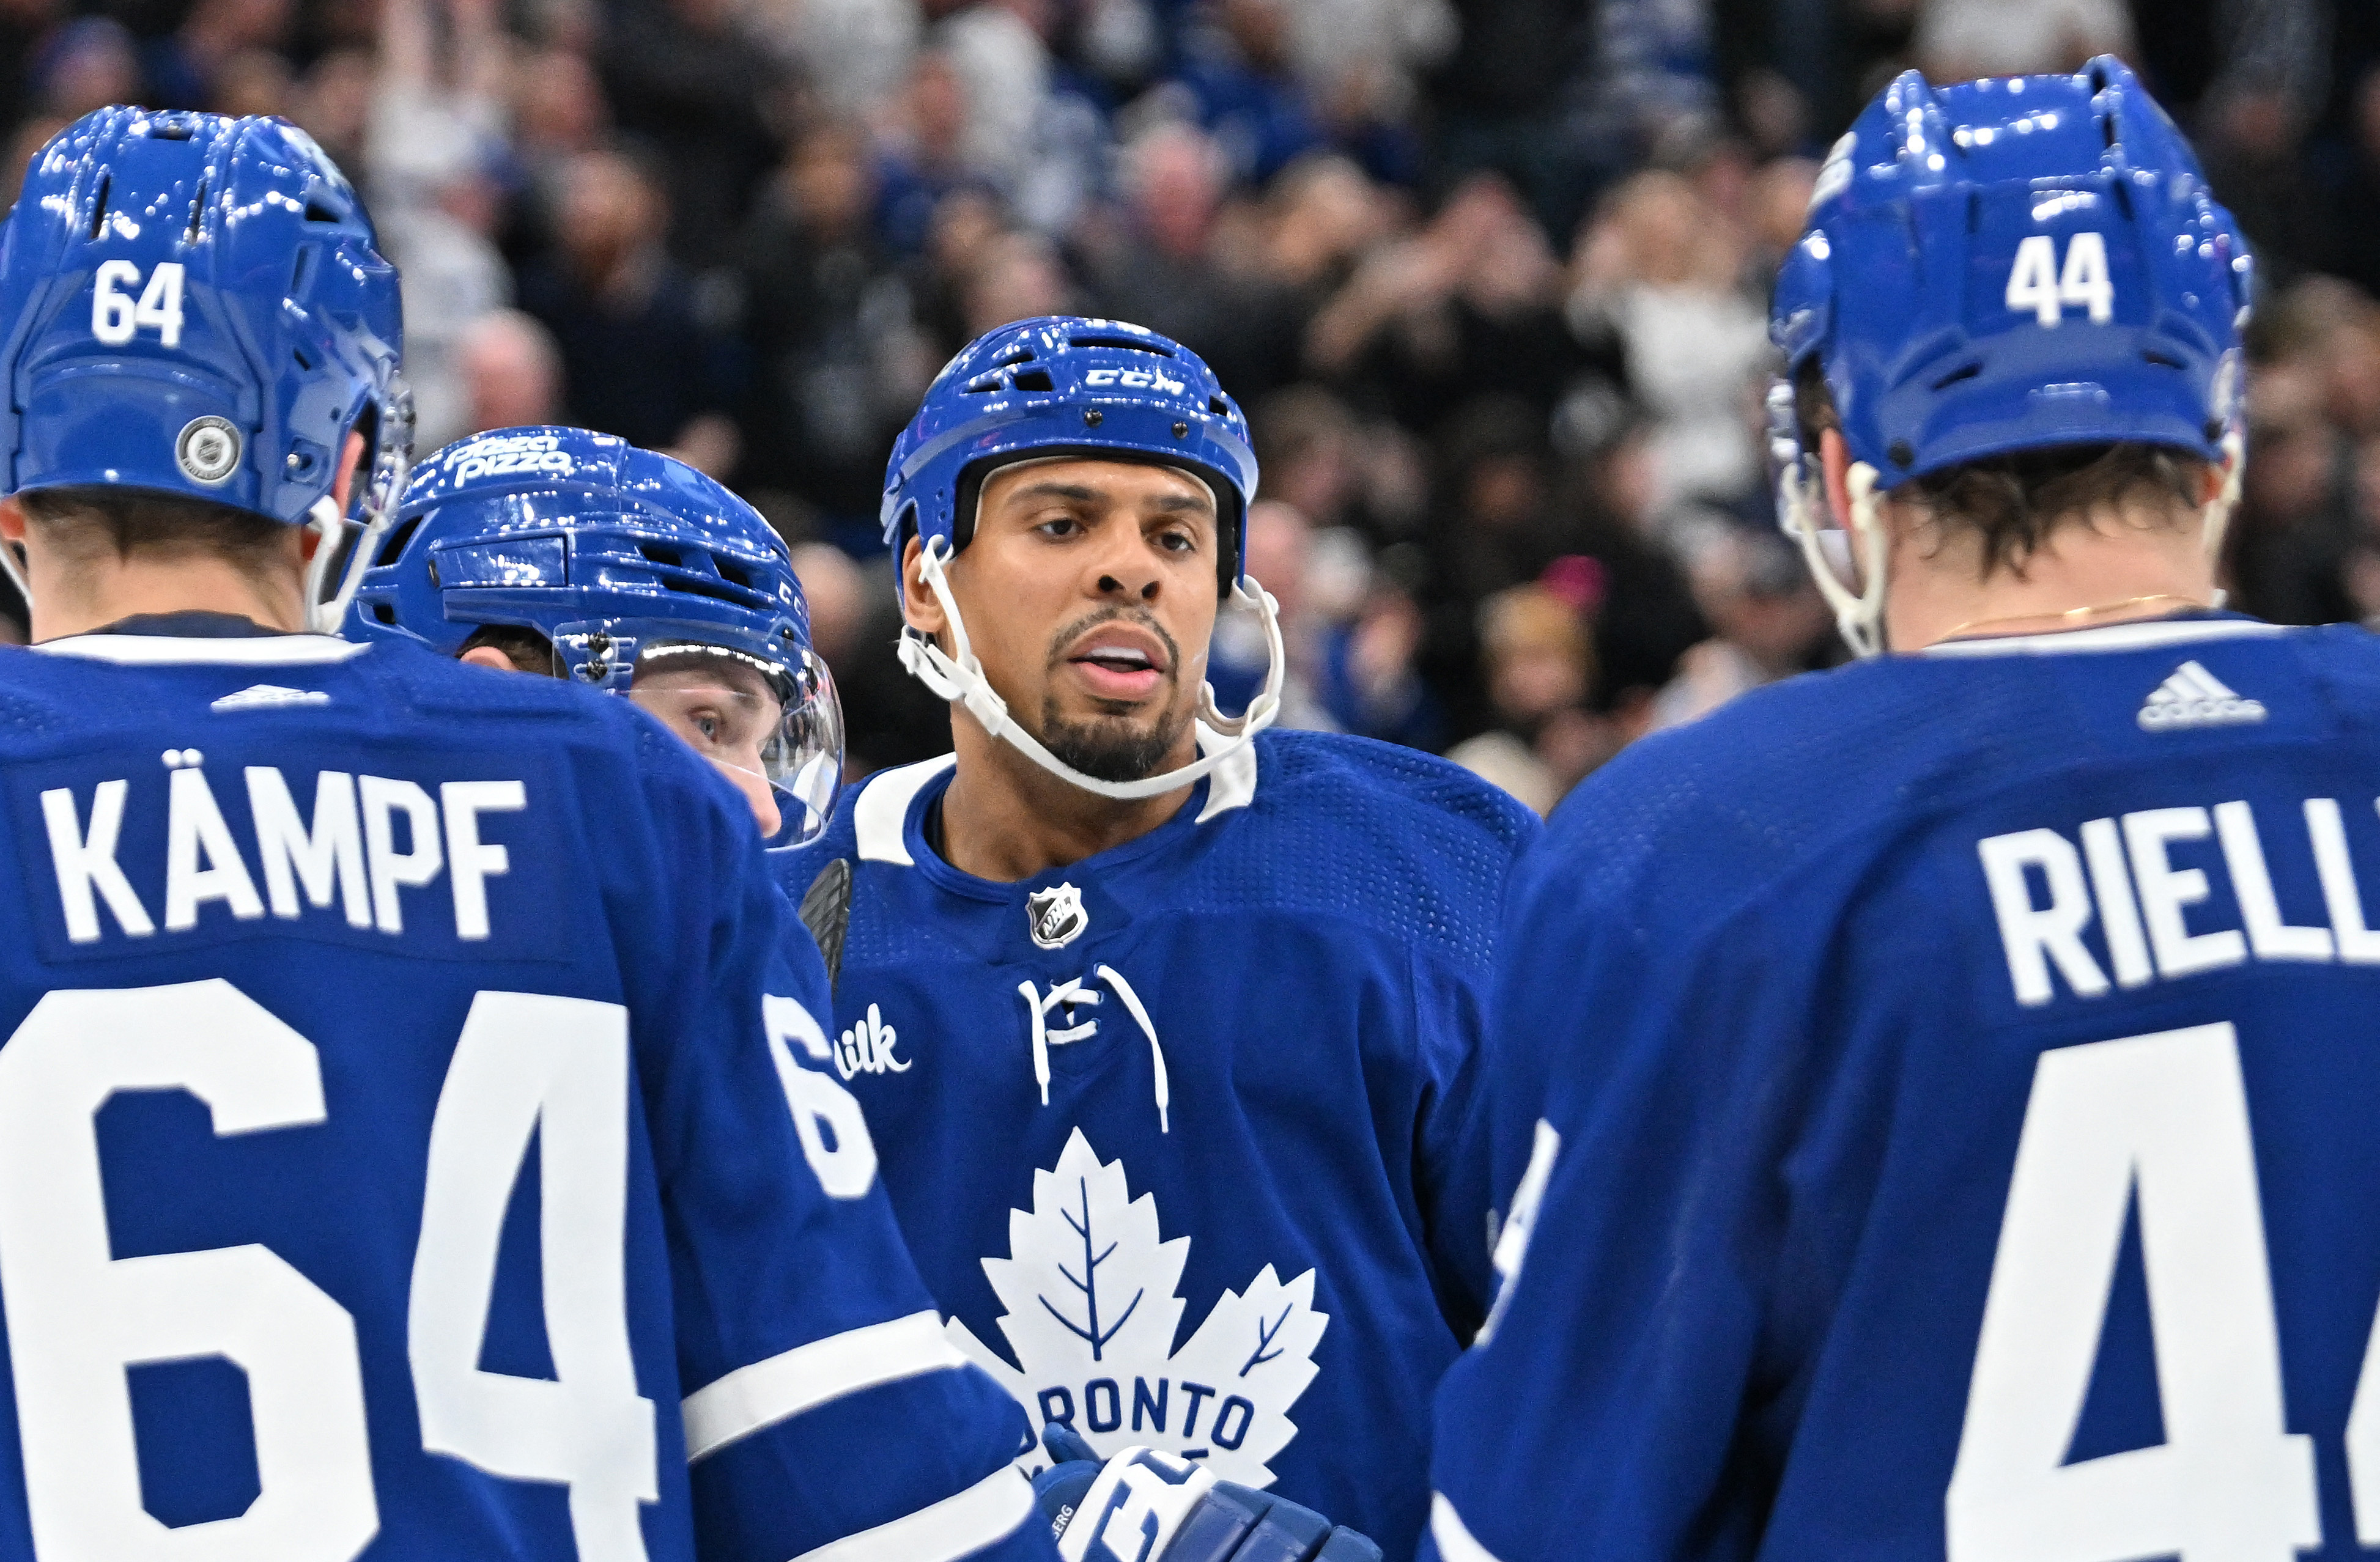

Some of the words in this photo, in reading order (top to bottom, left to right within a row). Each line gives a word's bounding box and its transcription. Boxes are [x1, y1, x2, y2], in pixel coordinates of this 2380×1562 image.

[92, 259, 185, 347] 64
[2005, 232, 2114, 328] 44
[1085, 367, 1185, 396] CCM
[443, 435, 559, 471] pizza
[454, 451, 572, 488] pizza
[40, 748, 527, 943] KÄMPF
[1977, 797, 2380, 1007] RIELL
[762, 993, 879, 1201] 6
[0, 977, 659, 1562] 64
